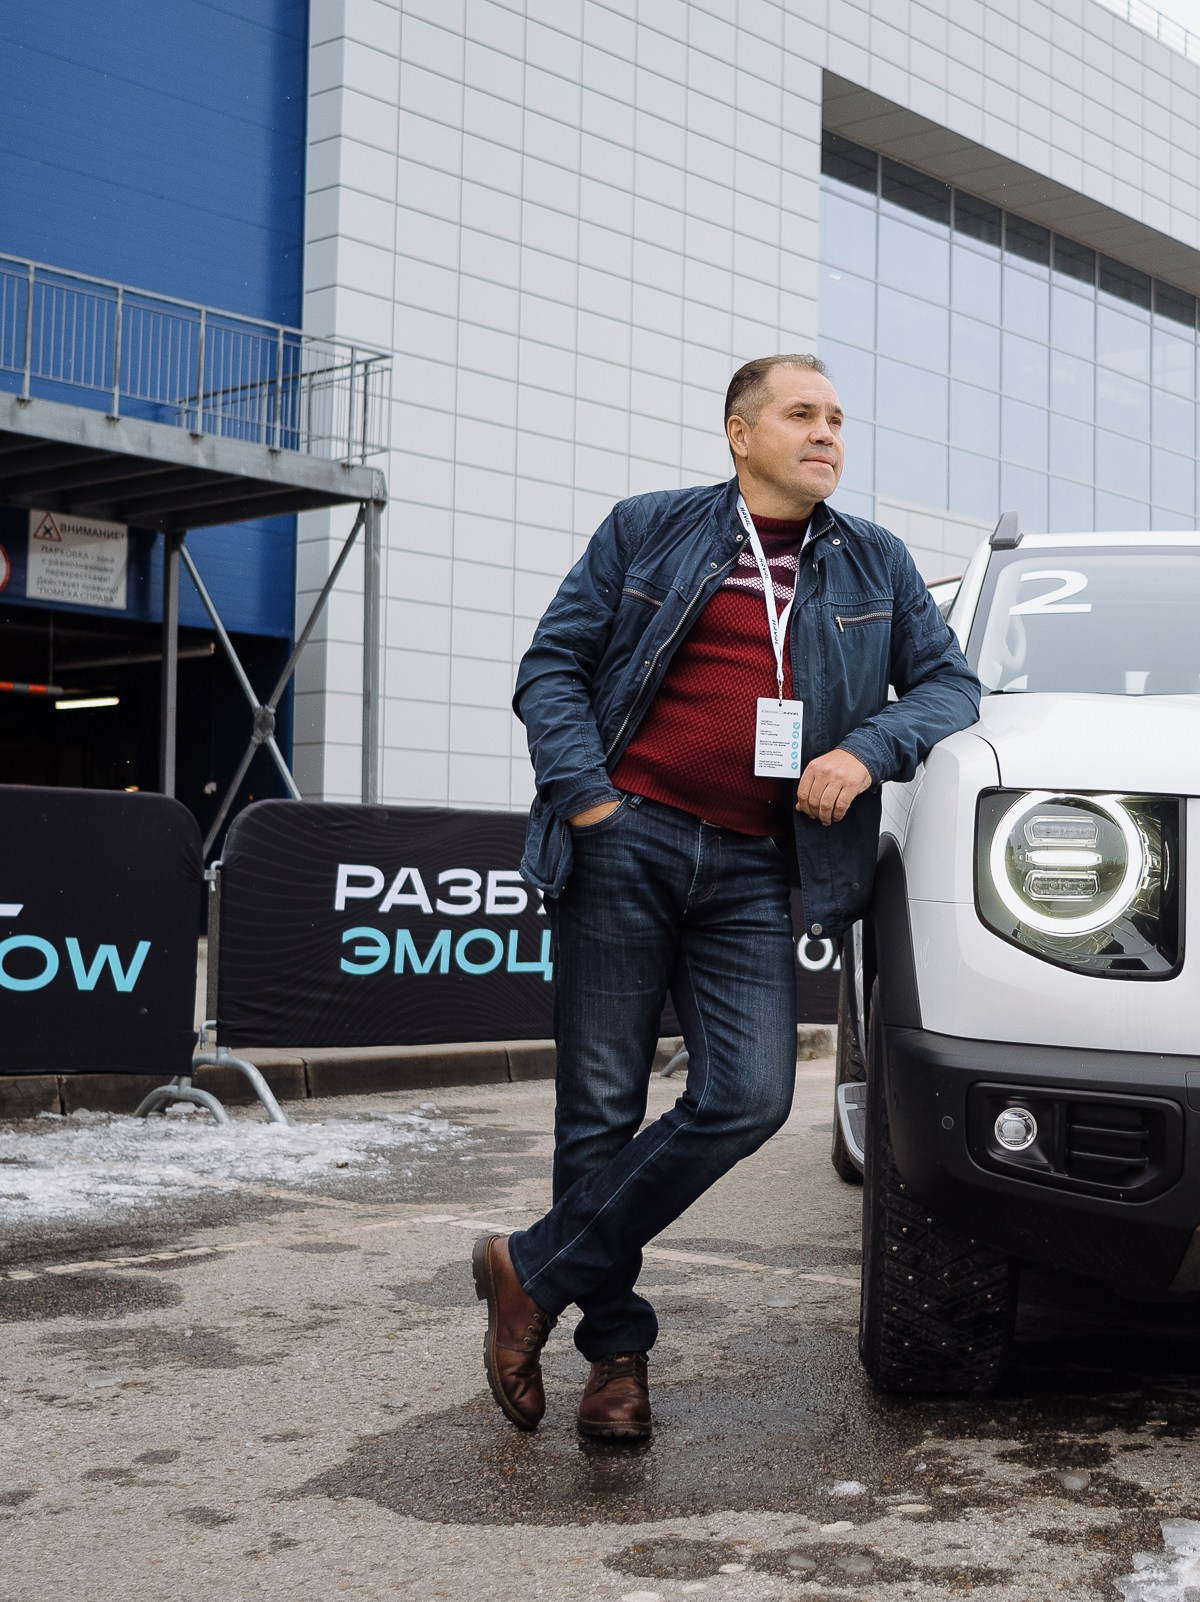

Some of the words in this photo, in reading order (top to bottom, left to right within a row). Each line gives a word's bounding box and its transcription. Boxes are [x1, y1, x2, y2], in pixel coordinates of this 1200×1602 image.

[60, 523, 124, 539] ВНИМАНИЕ!
[1009, 570, 1092, 615] 2
[0, 935, 151, 992] OW
[340, 926, 553, 982] ЭМОЦ
